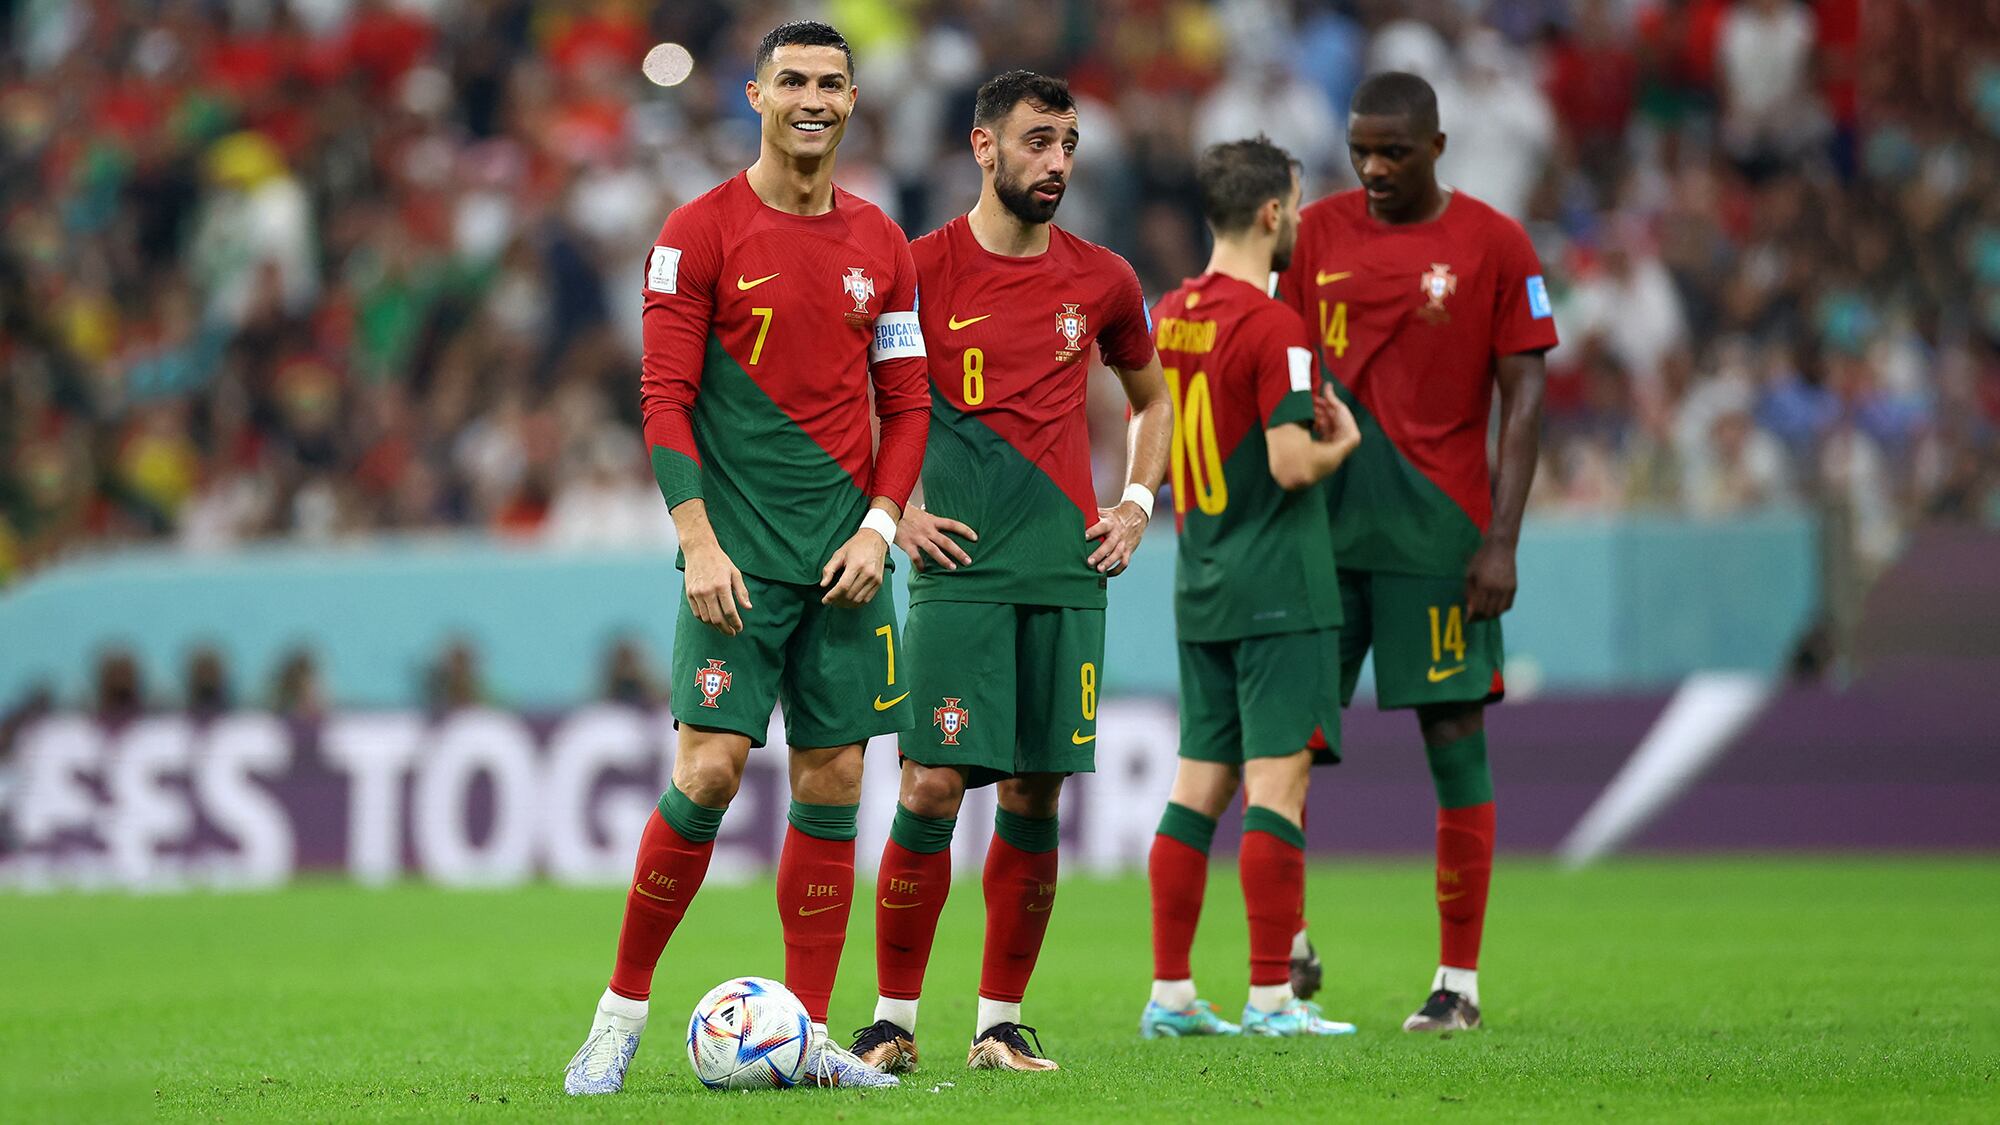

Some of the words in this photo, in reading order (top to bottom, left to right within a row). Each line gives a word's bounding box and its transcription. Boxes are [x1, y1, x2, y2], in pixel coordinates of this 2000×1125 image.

[749, 307, 773, 365] 7
[876, 336, 895, 351] FOR
[898, 335, 916, 347] ALL
[1319, 299, 1349, 359] 14
[962, 347, 985, 406] 8
[1163, 368, 1229, 517] 10
[875, 624, 895, 686] 7
[1428, 604, 1467, 662] 14
[1080, 662, 1096, 720] 8
